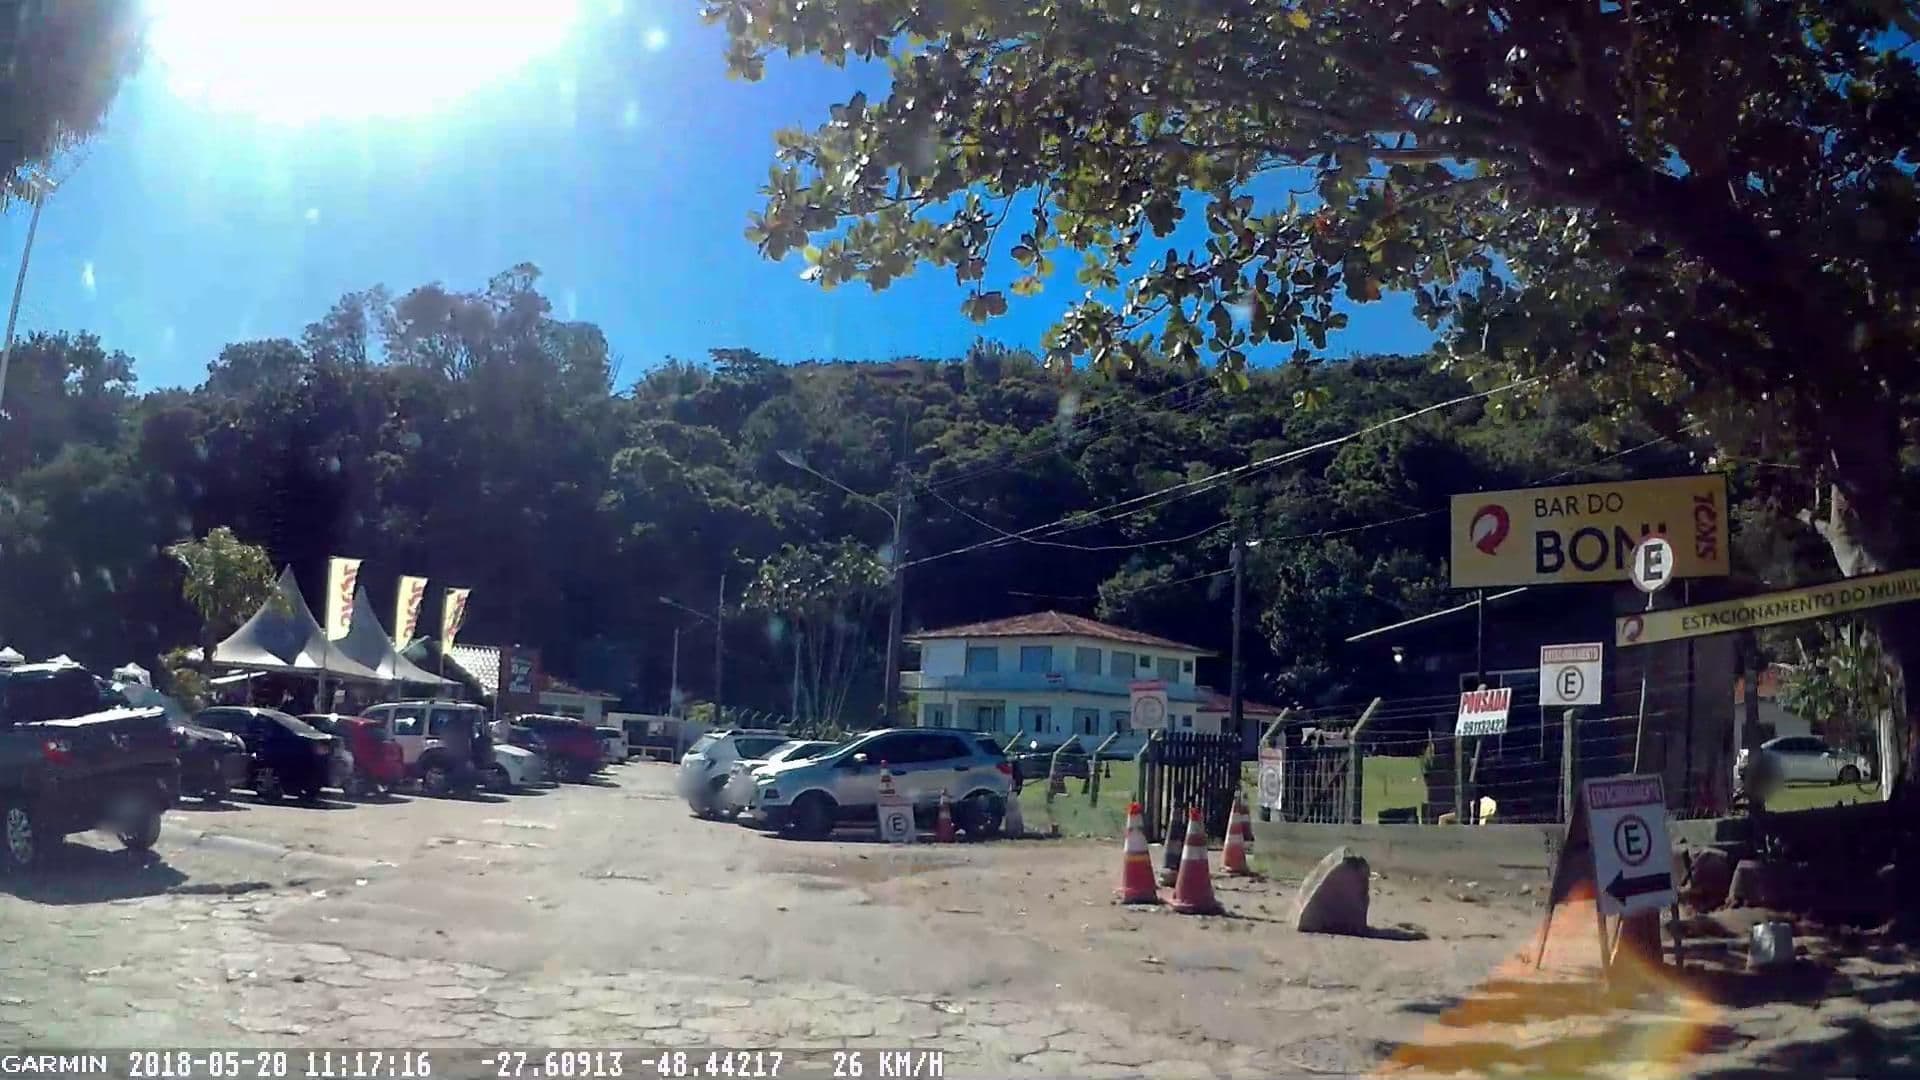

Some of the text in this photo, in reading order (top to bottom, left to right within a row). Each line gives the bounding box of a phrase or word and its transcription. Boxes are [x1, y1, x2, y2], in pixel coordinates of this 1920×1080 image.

[1534, 492, 1623, 518] BAR DO
[1643, 543, 1664, 582] E
[1681, 592, 1834, 631] ESTACIONAMENTO
[1840, 587, 1866, 605] DO
[1564, 672, 1577, 695] E
[1460, 689, 1509, 715] POUSADA
[1624, 824, 1642, 856] E
